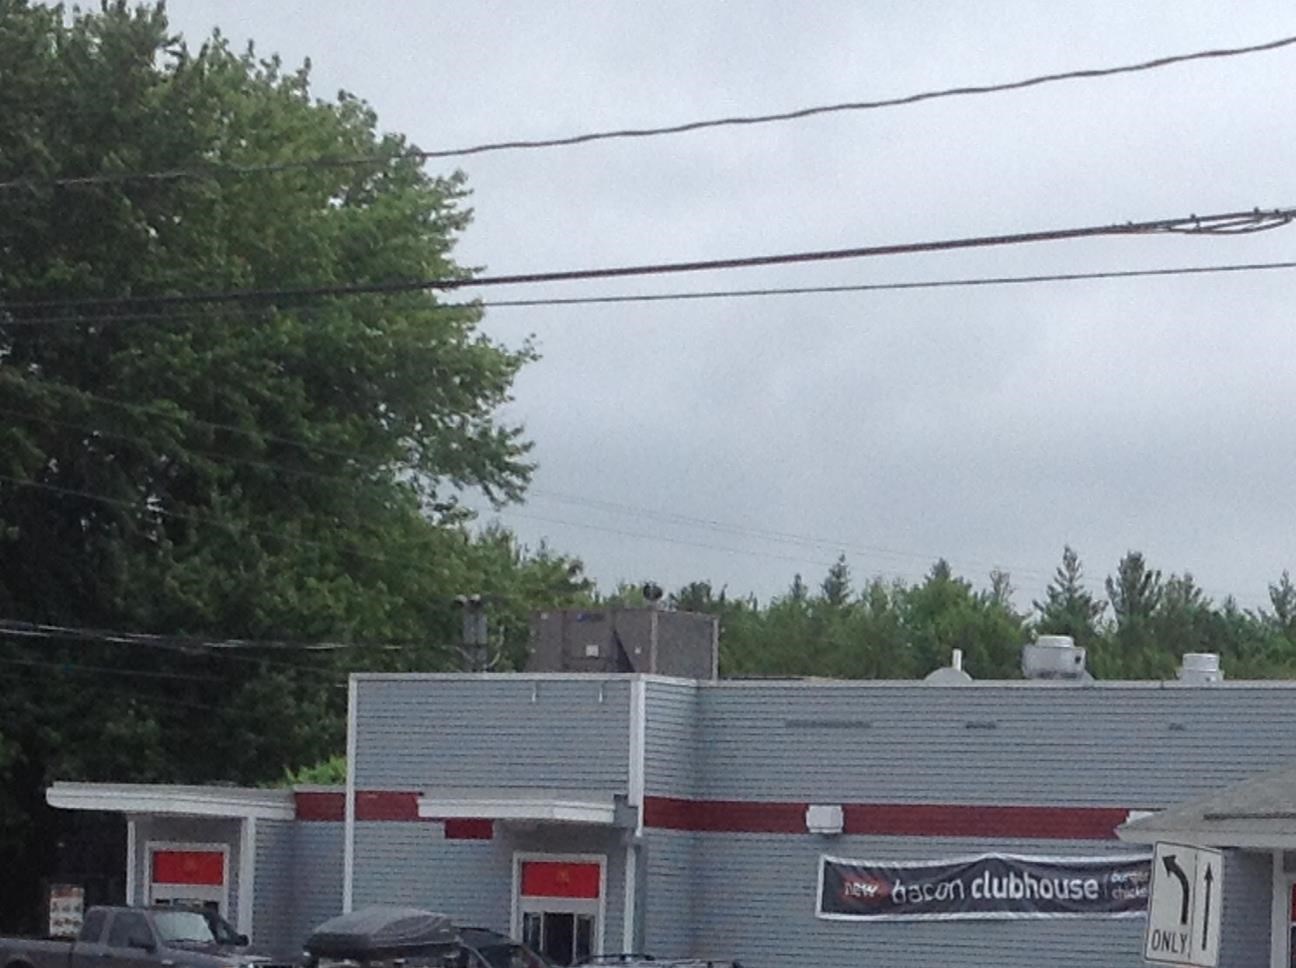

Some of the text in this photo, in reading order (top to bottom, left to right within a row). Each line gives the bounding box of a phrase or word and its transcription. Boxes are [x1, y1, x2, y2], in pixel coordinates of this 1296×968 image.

[891, 878, 966, 905] bacon
[970, 869, 1100, 900] clubhouse
[1150, 928, 1189, 955] ONLY
